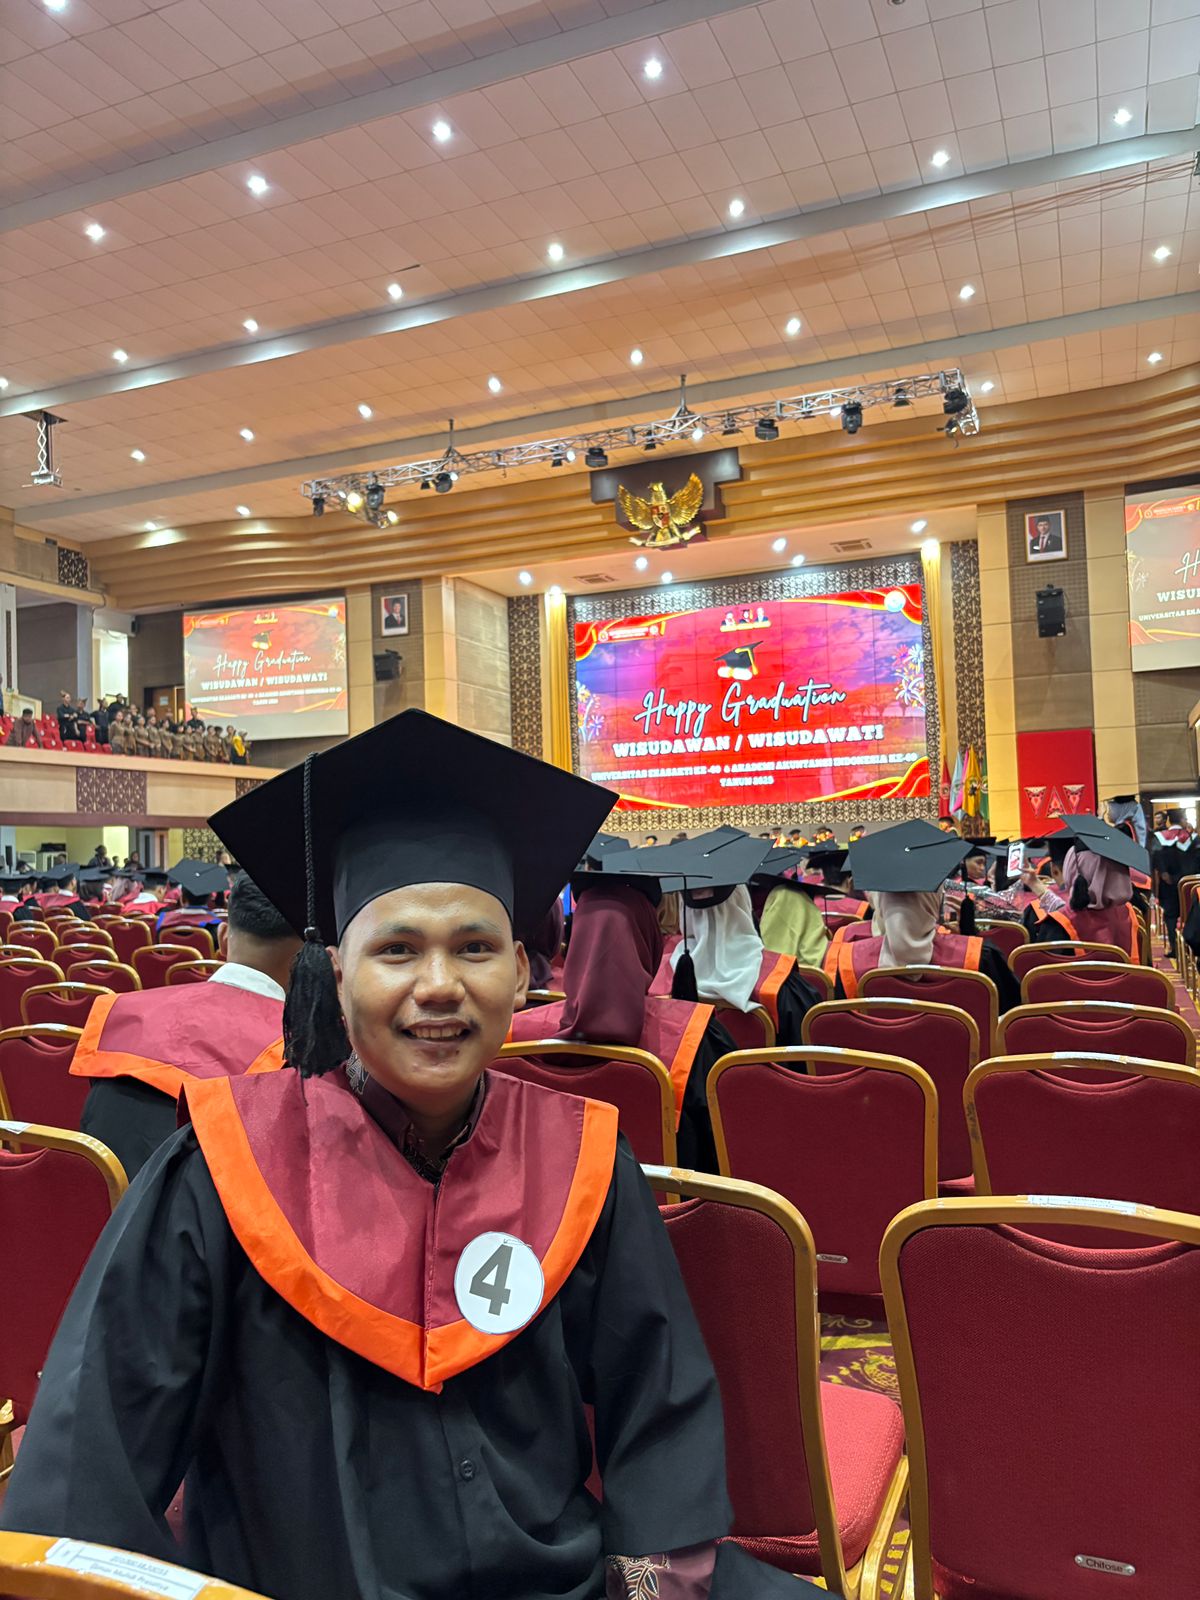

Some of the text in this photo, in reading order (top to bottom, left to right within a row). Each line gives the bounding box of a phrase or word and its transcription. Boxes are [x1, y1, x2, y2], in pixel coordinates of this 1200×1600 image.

[213, 650, 311, 678] Happy Graduation
[201, 677, 258, 691] WISUDAWAN
[266, 672, 327, 686] WISUDAWATI
[634, 678, 847, 737] Happy Graduation
[612, 724, 884, 758] WISUDAWAN / WISUDAWATI
[591, 769, 647, 782] UNIVERSITAS
[469, 1244, 513, 1316] 4
